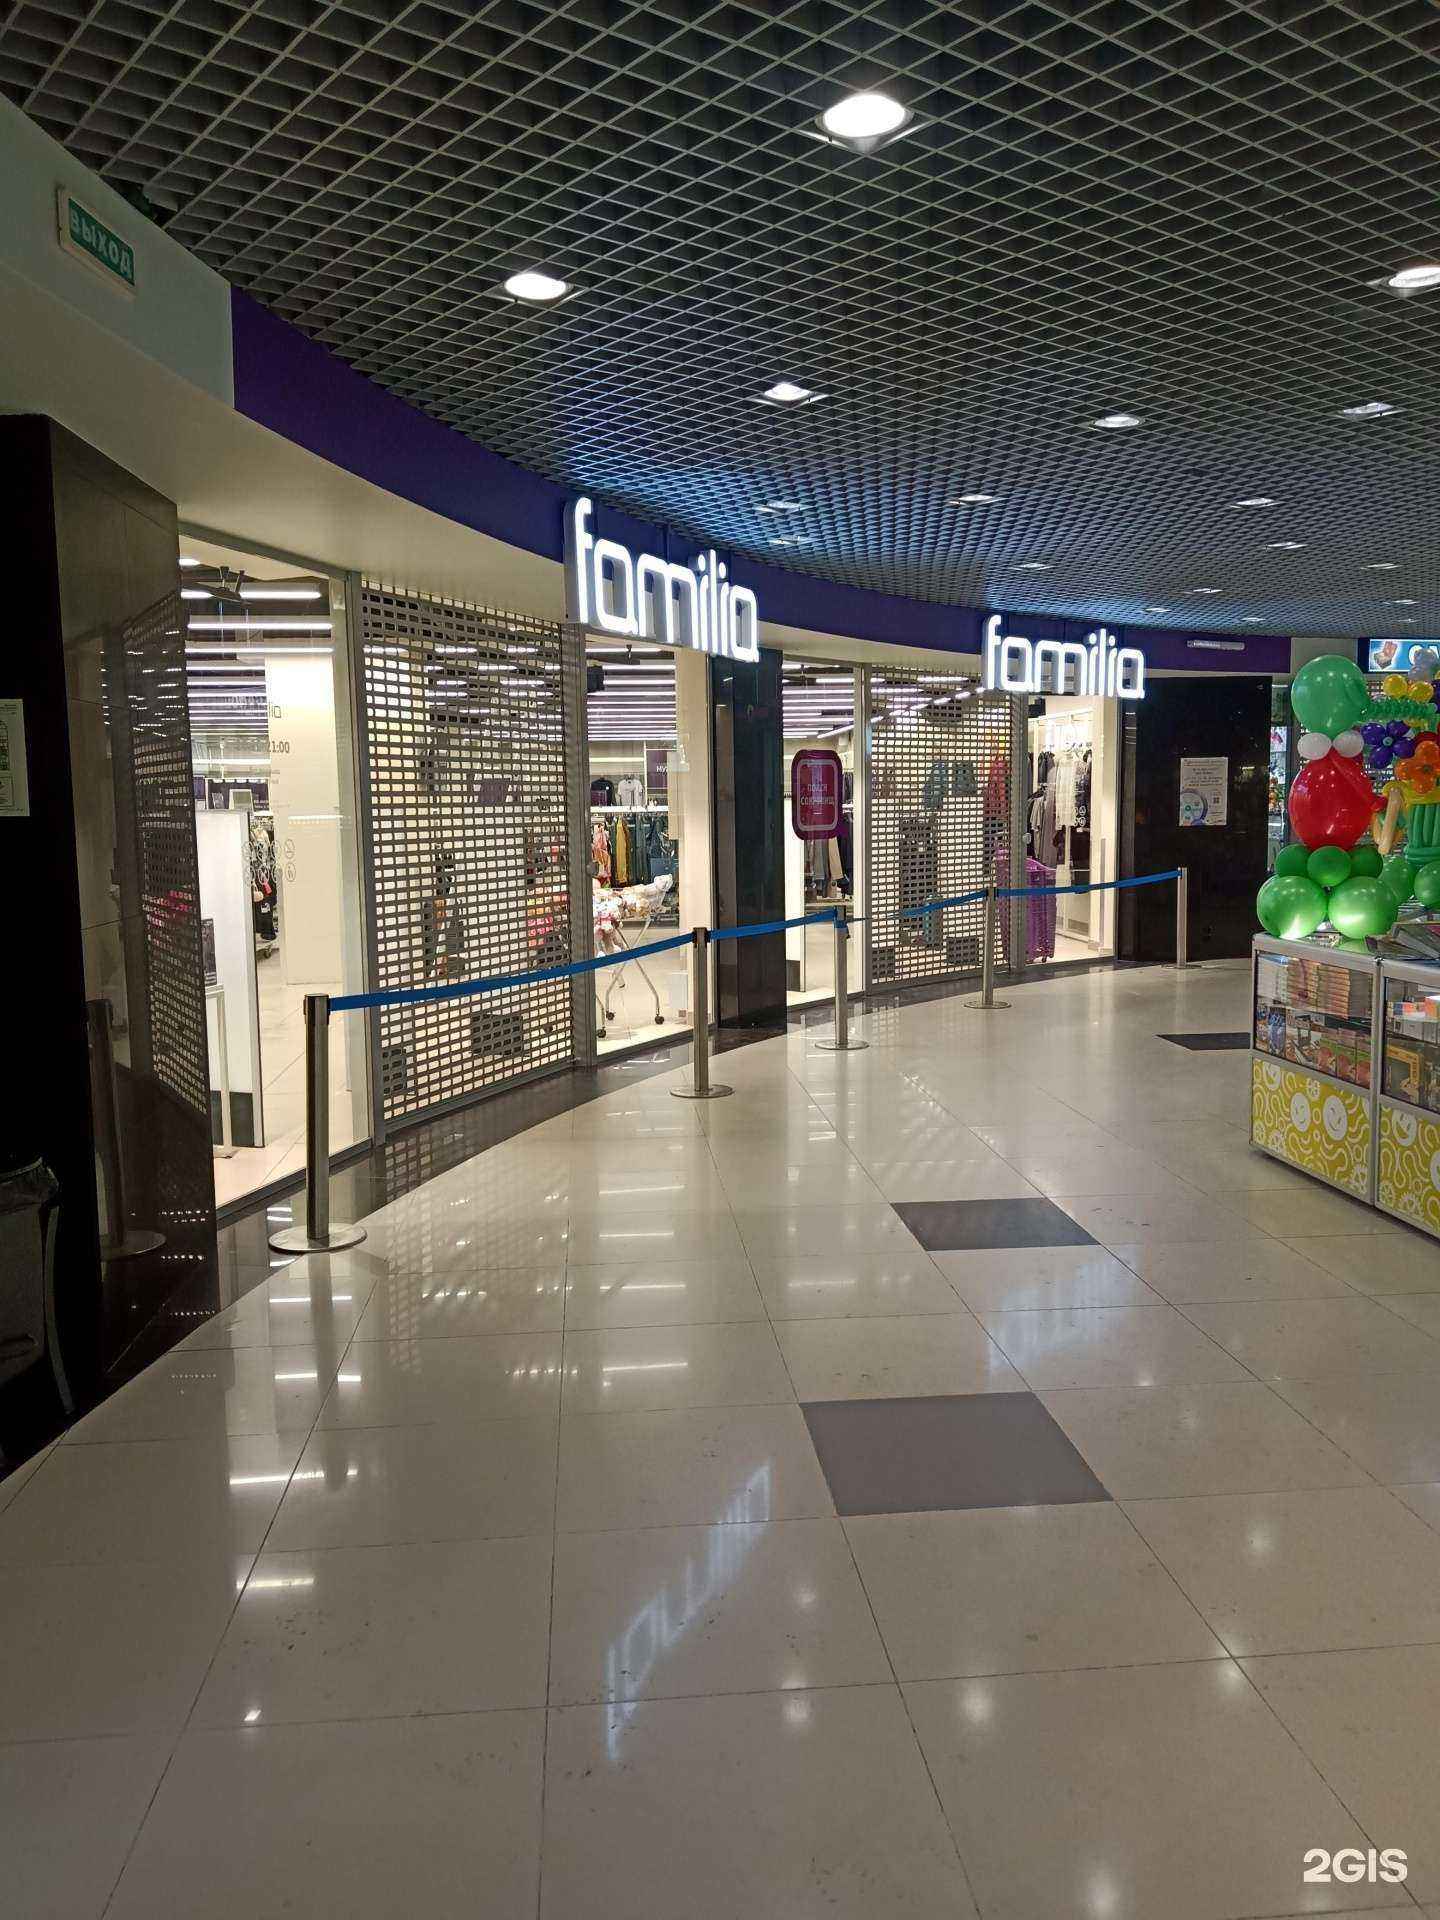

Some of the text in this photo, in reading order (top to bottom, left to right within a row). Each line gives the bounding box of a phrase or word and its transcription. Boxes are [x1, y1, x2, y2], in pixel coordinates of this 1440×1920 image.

[70, 209, 133, 279] ВЫХОД
[572, 496, 760, 663] familia
[986, 614, 1146, 699] familia
